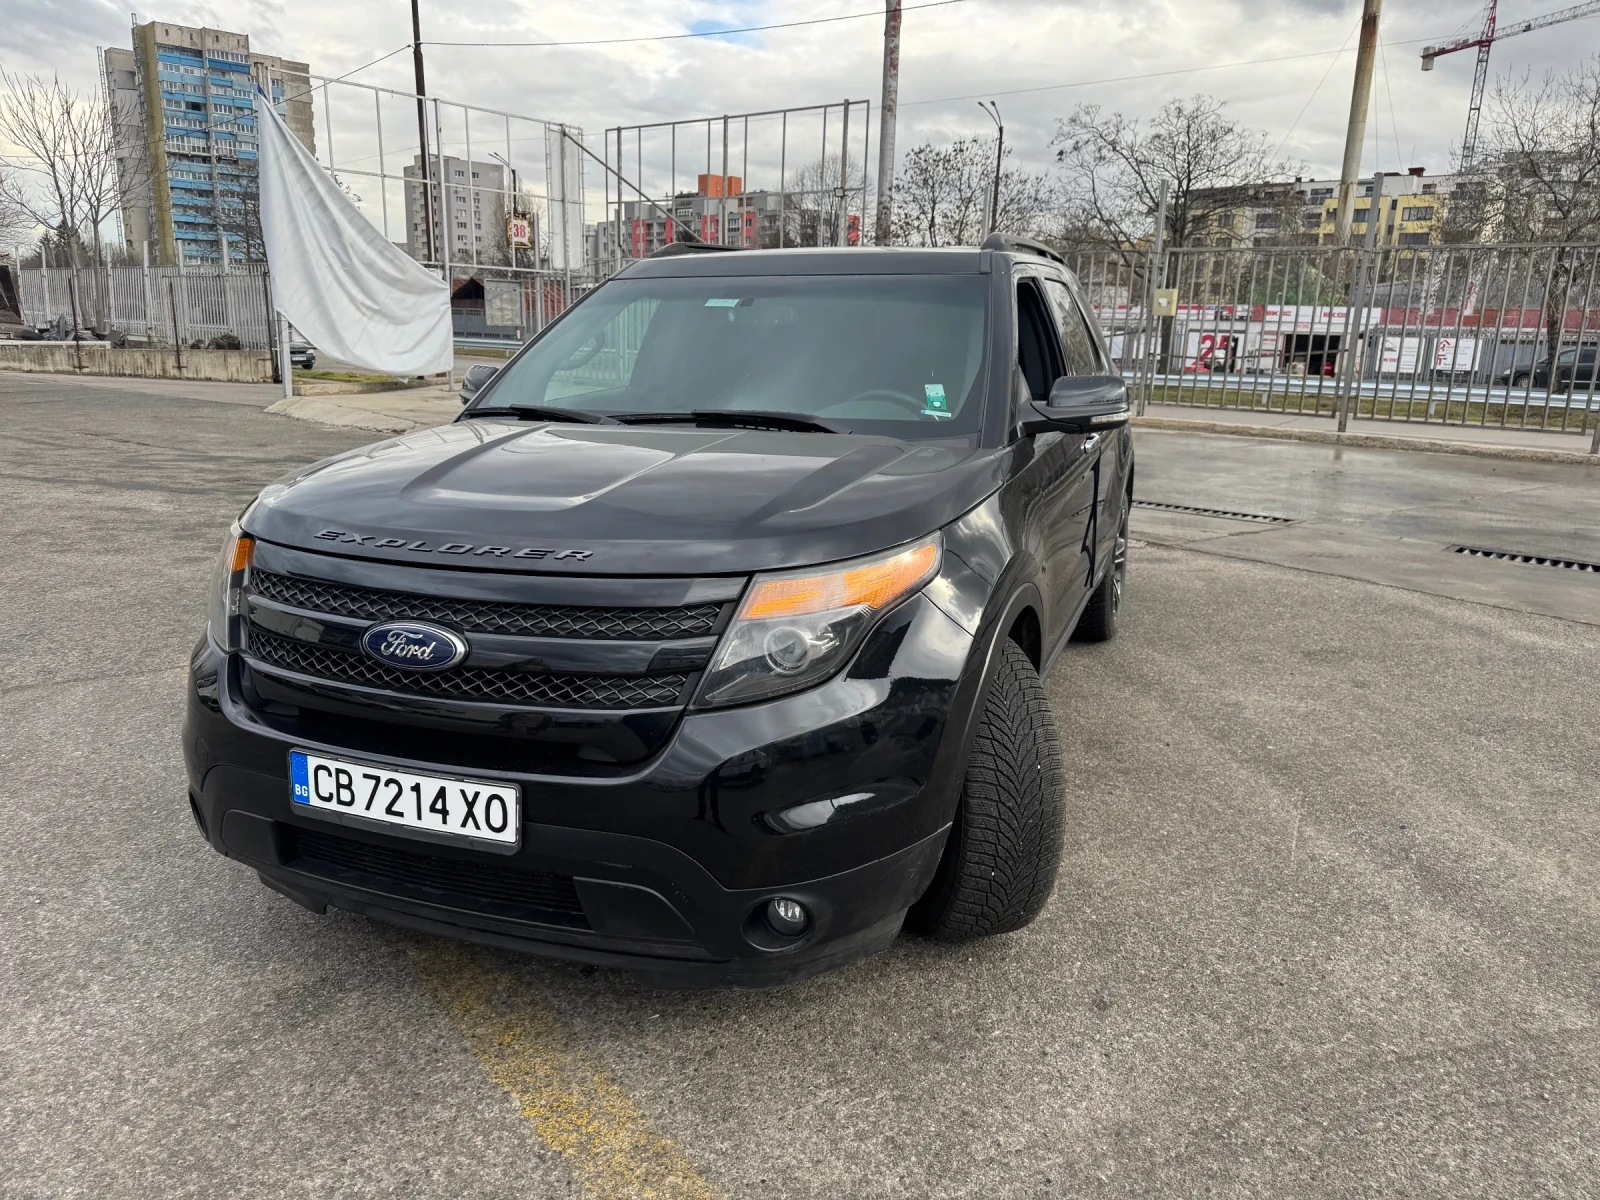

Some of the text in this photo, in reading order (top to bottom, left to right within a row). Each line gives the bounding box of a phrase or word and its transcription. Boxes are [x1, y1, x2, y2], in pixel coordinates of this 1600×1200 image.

[513, 223, 526, 238] 38
[313, 529, 594, 561] EXPLORER
[380, 630, 434, 661] Ford
[294, 783, 309, 797] BG
